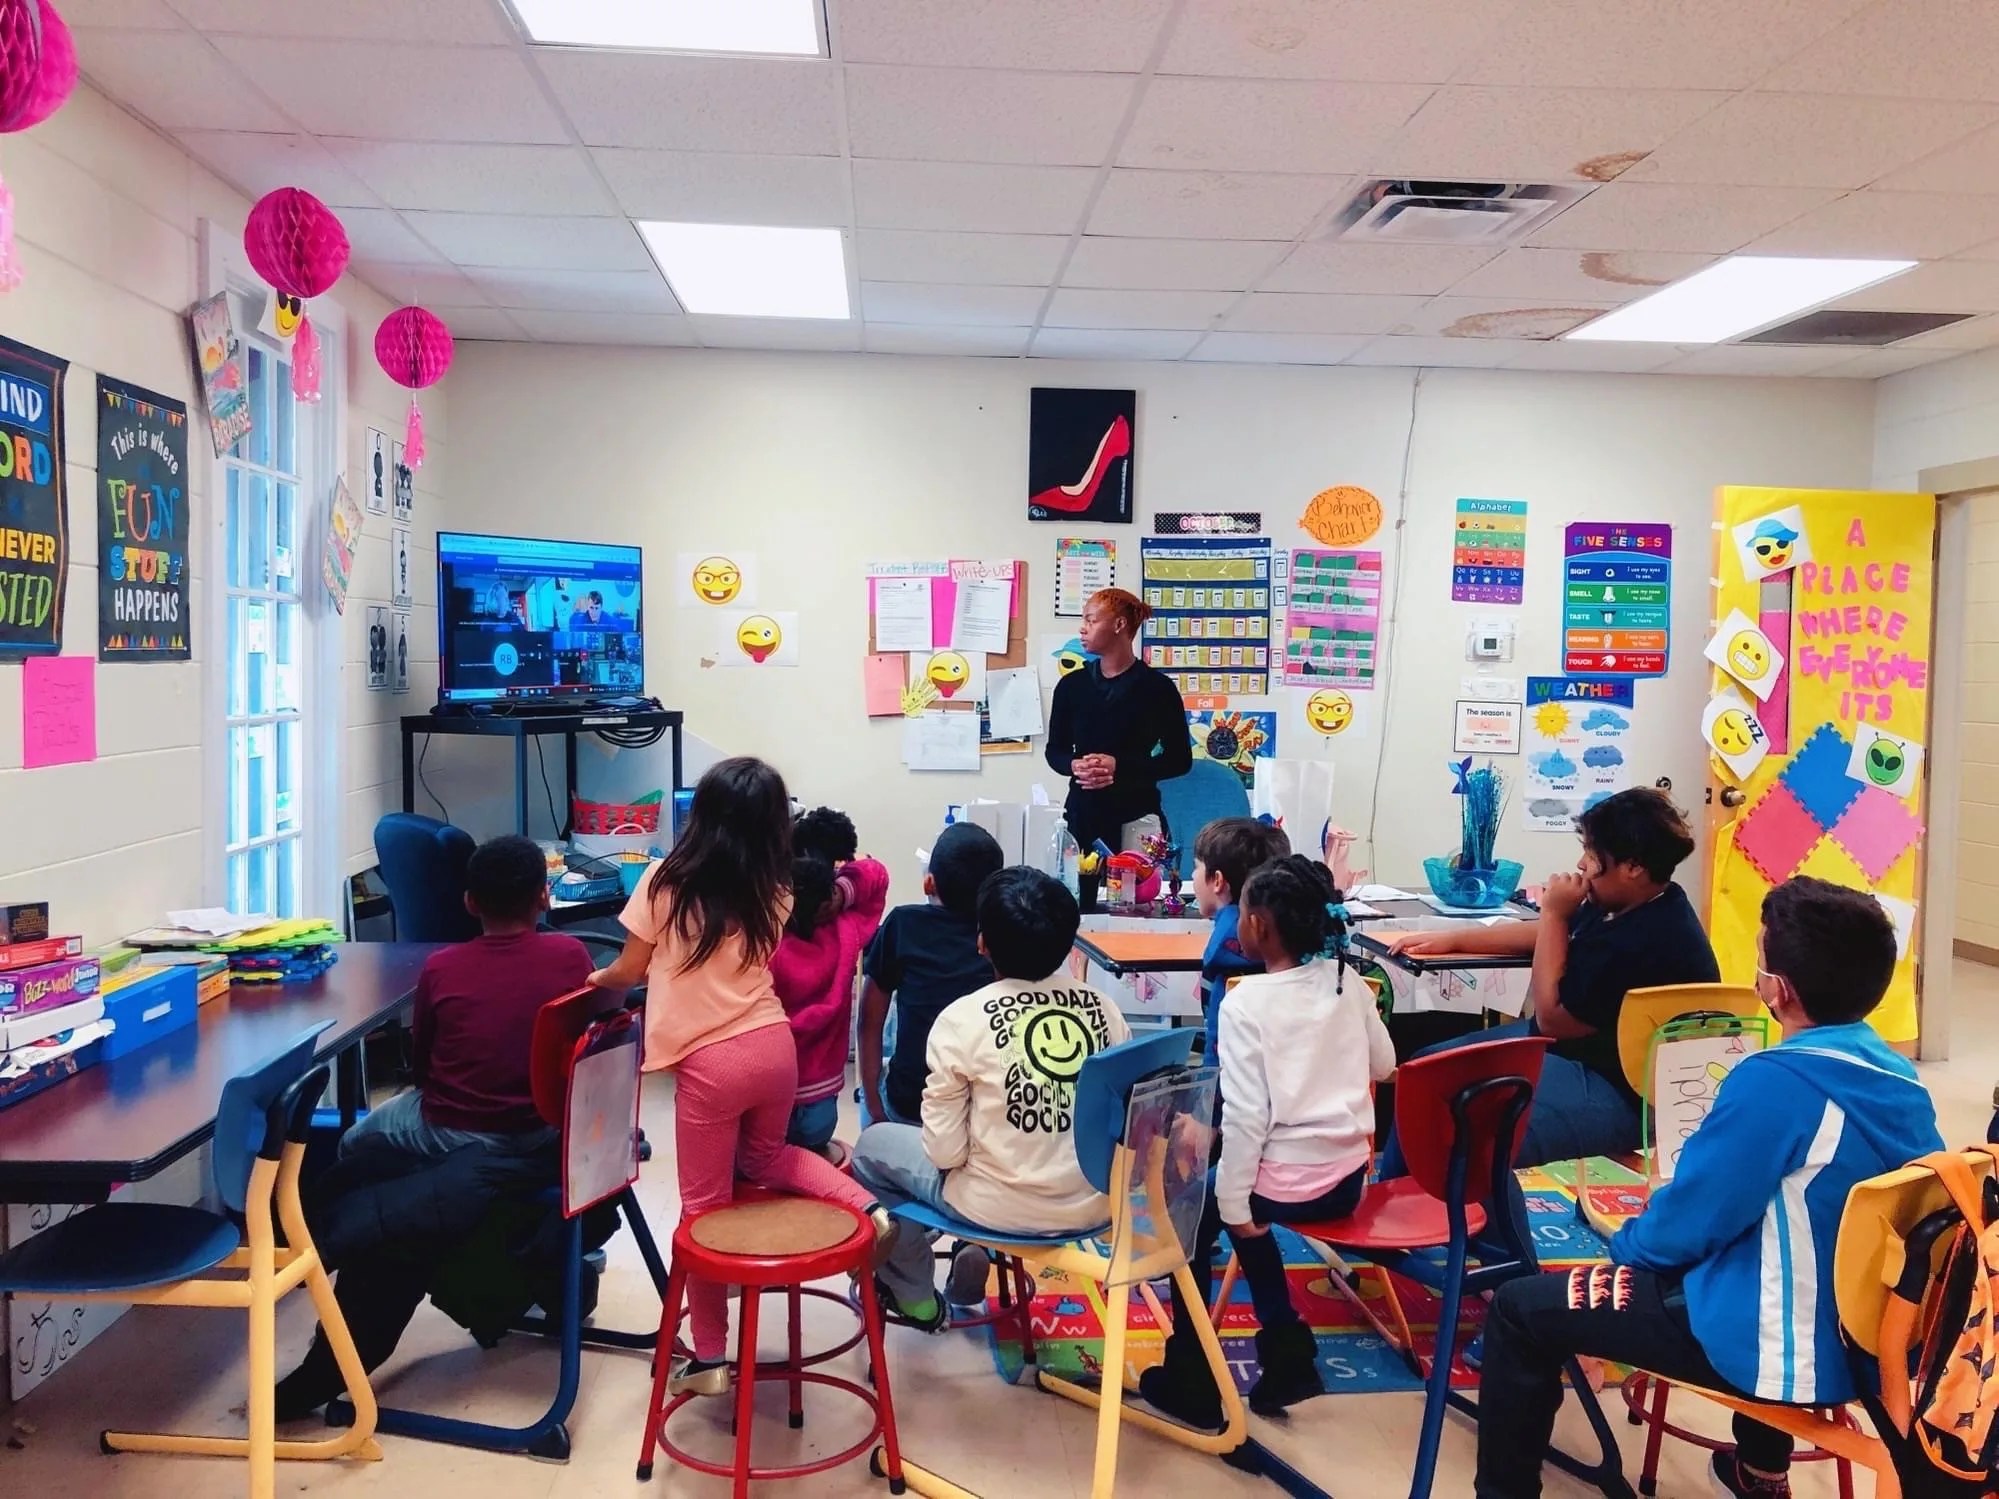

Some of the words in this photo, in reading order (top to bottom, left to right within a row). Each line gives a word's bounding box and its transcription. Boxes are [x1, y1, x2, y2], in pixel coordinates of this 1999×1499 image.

[111, 427, 135, 461] This
[138, 423, 148, 447] is
[150, 431, 179, 475] where
[107, 479, 180, 542] FUN
[1470, 502, 1512, 512] Alphabet
[1574, 536, 1604, 546] FIVE
[1610, 536, 1662, 548] SENSES
[1846, 518, 1866, 547] A
[110, 545, 183, 585] STUFF
[1801, 561, 1911, 595] PLACE
[114, 588, 179, 622] HAPPENS
[1798, 605, 1908, 642] WHERE
[500, 655, 512, 665] RB
[1798, 643, 1927, 689] EVERYONE
[1197, 698, 1215, 708] Fall
[1535, 682, 1628, 697] WEATHER
[1505, 709, 1512, 717] is
[1840, 691, 1893, 721] ITS
[983, 991, 1050, 1014] GOOD
[1052, 988, 1101, 1009] DAZE
